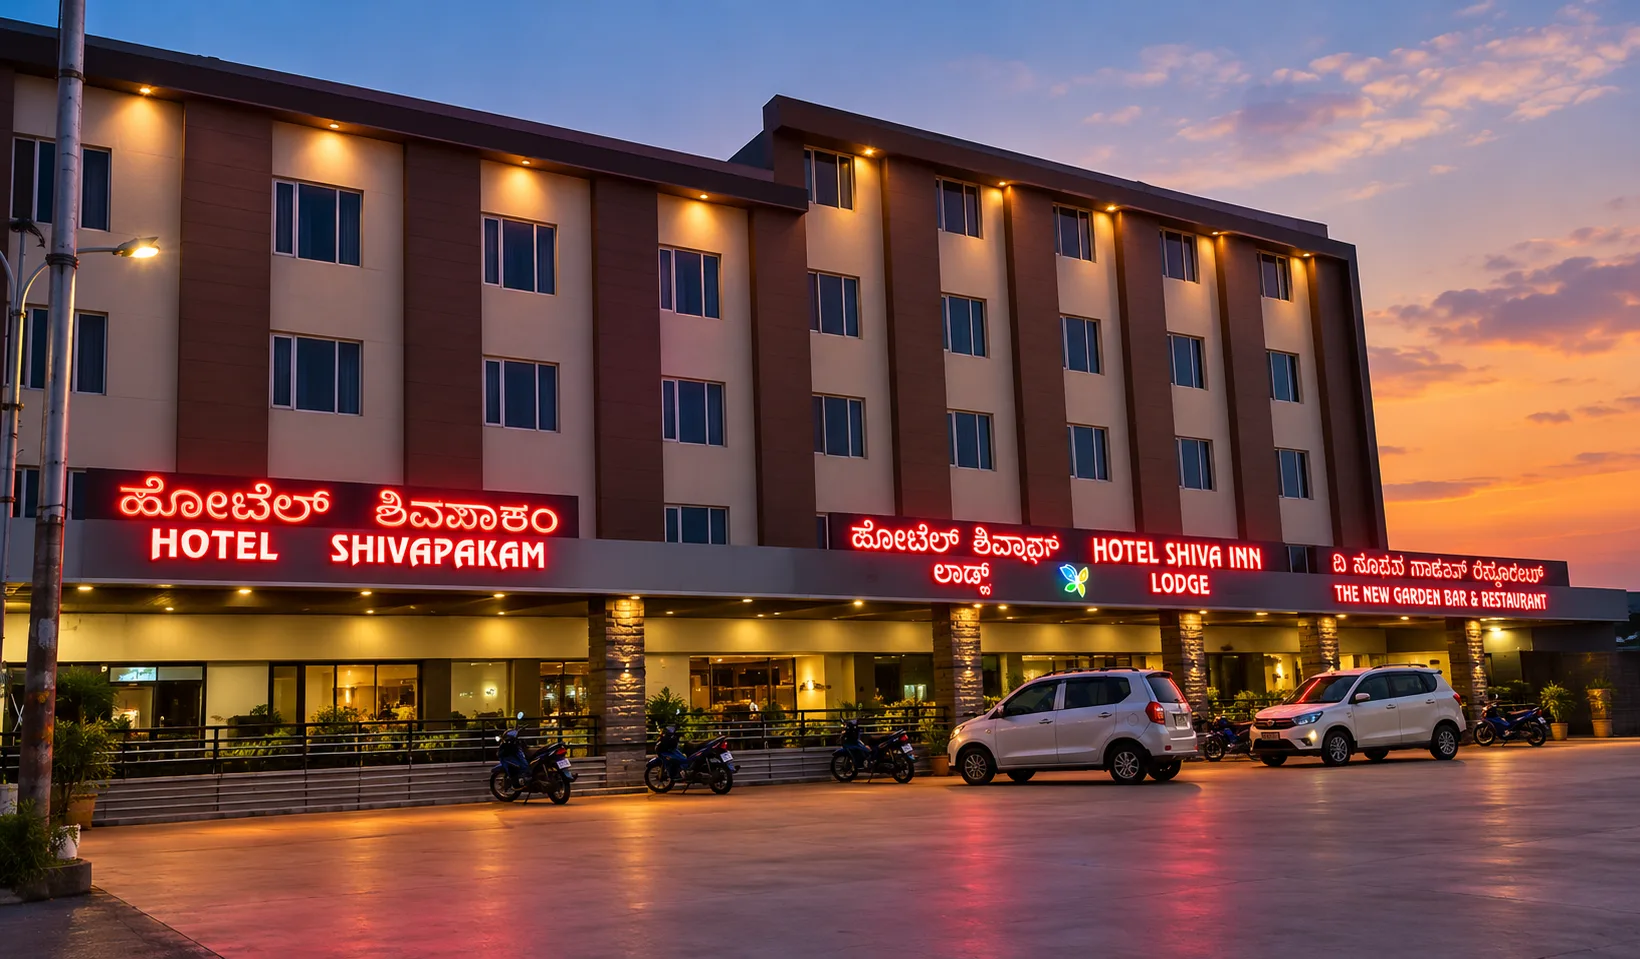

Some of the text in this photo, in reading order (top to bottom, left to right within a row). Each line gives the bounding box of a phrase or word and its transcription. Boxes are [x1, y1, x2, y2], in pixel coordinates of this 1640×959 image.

[120, 476, 330, 523] ಹೋಟೆಲ್
[151, 527, 545, 570] HOTEL SHIVAPAKAM
[851, 519, 960, 553] ಹೋಟೆಲ್
[1093, 537, 1262, 570] HOTEL SHIVA INN
[1151, 572, 1211, 595] LODGE
[1334, 584, 1547, 611] THE NEW GARDEN BAR & RESTAURANT
